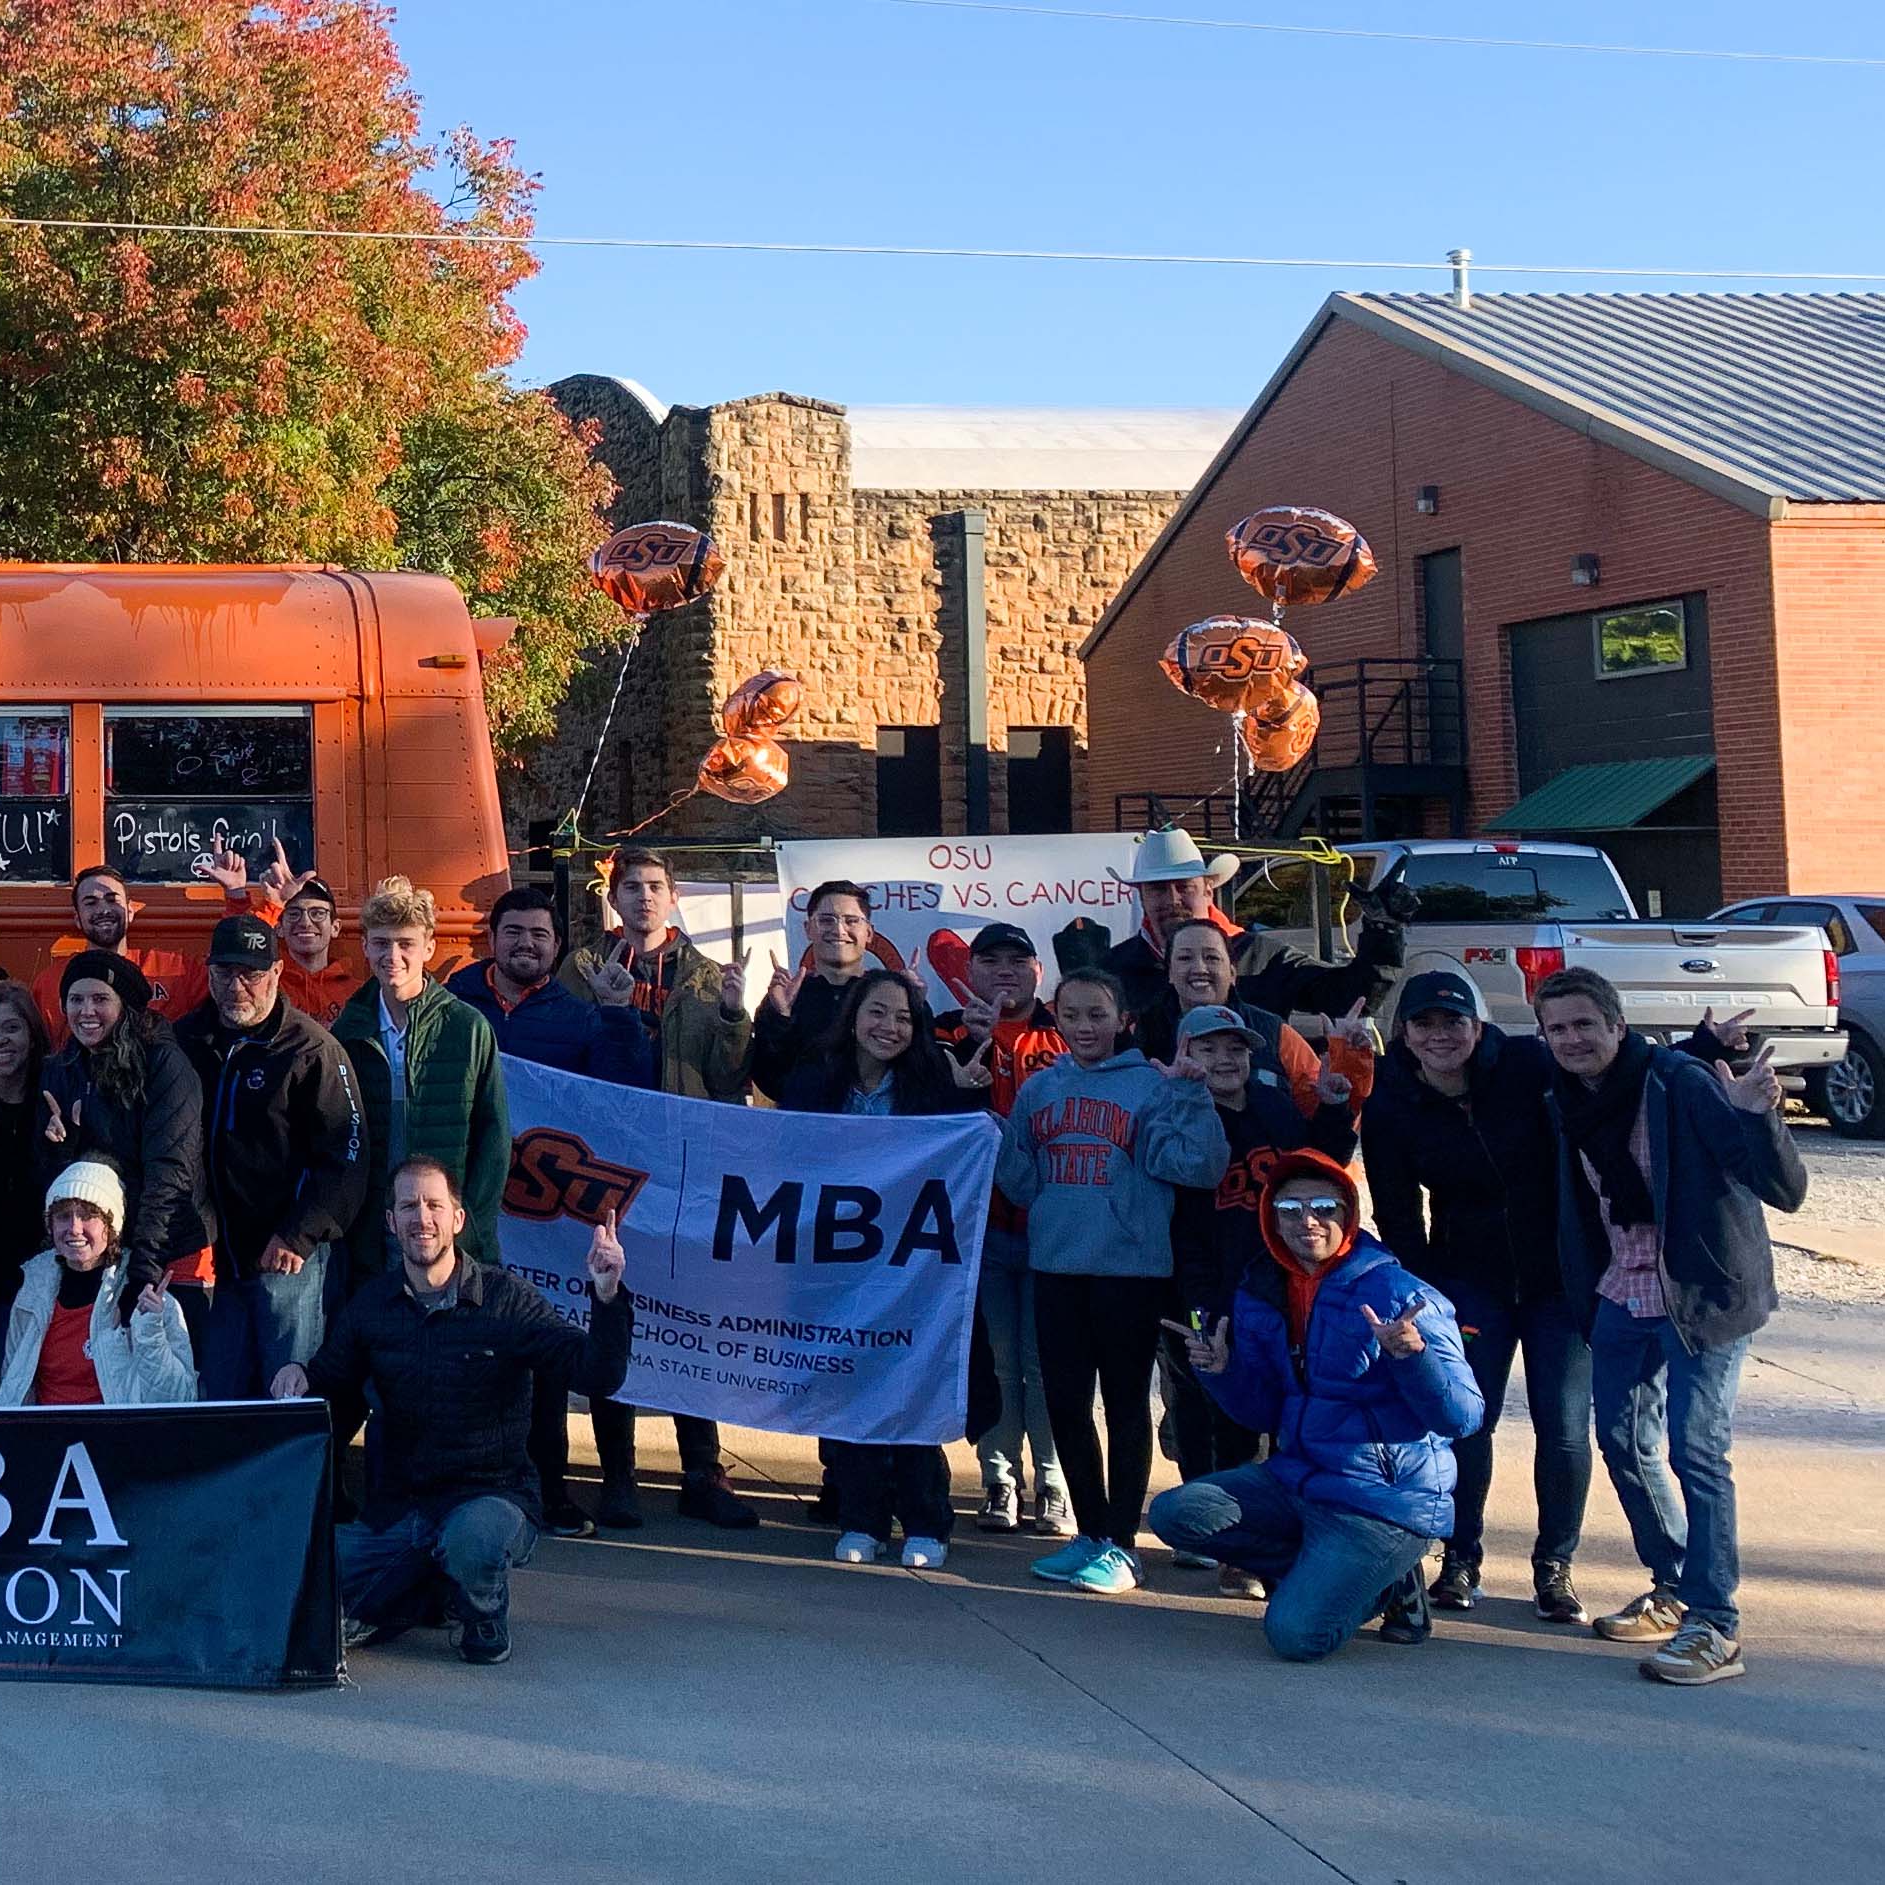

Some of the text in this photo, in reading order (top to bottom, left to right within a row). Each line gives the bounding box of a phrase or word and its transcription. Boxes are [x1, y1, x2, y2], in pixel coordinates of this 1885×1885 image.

[605, 532, 691, 571] OSU
[1247, 522, 1349, 567] OSU
[1197, 637, 1283, 681] OSU
[114, 813, 201, 855] Pistols
[929, 844, 992, 870] OSU
[791, 879, 1133, 912] CCHES VS. CANCER
[1464, 947, 1506, 963] FX4
[500, 1127, 962, 1267] SU MBA
[632, 1322, 711, 1354] CHOOL
[716, 1341, 749, 1359] OF
[753, 1346, 855, 1374] BUSINESS
[717, 1314, 913, 1348] ADMINISTRATION
[659, 1359, 712, 1382] STATE
[716, 1370, 812, 1396] UNIVERSITY
